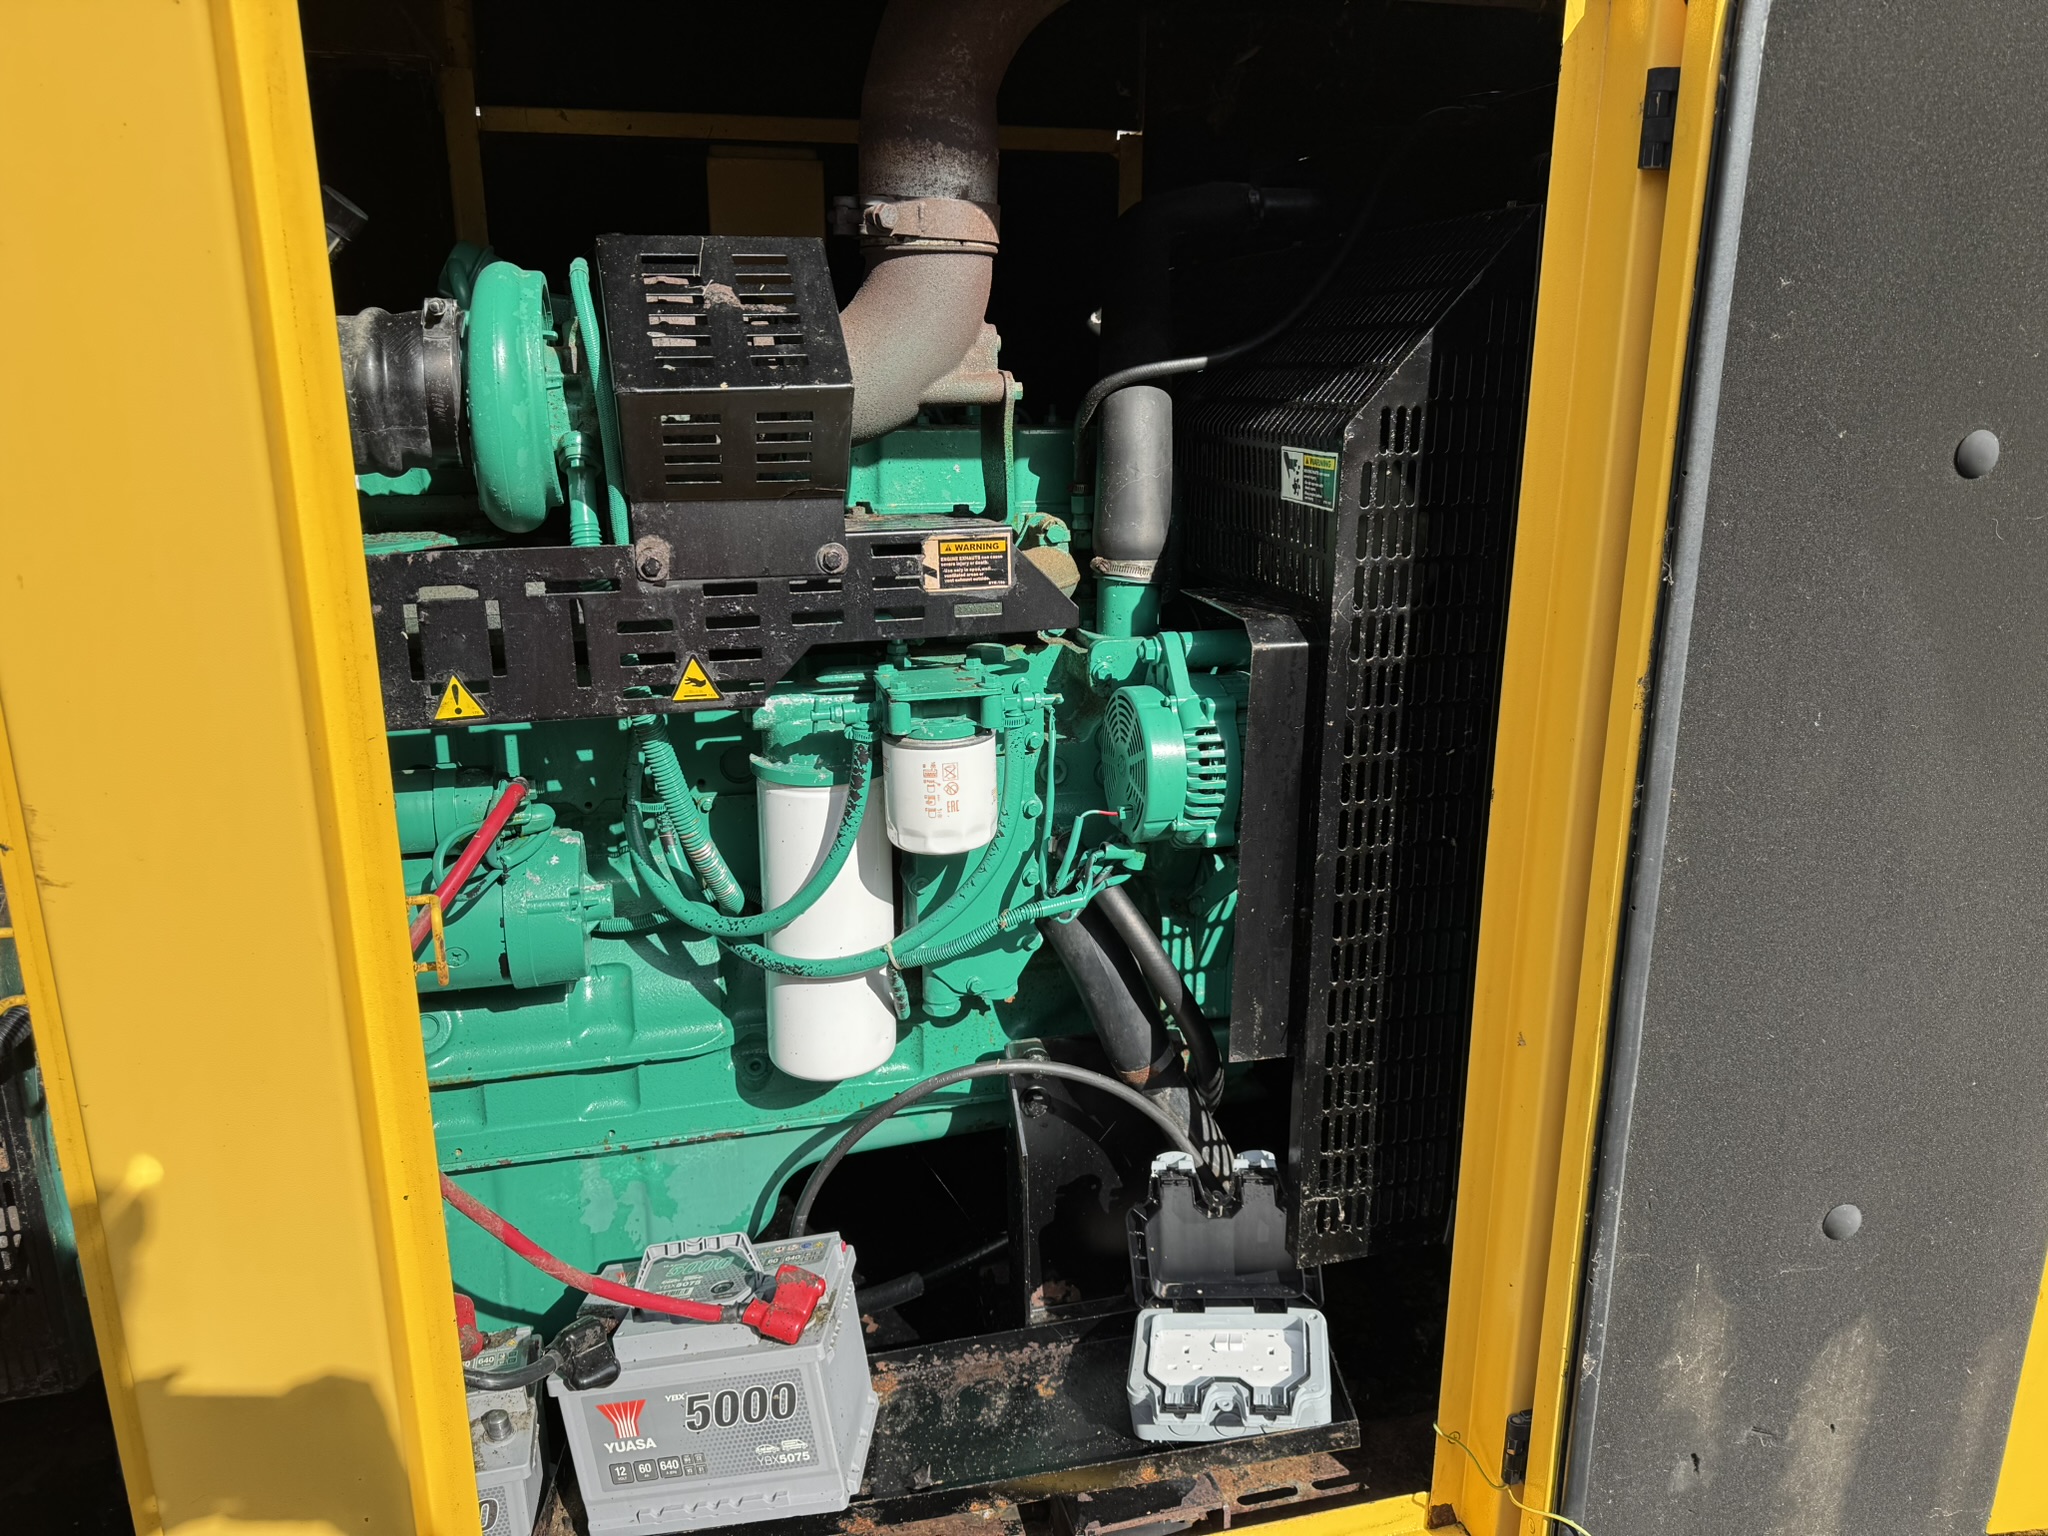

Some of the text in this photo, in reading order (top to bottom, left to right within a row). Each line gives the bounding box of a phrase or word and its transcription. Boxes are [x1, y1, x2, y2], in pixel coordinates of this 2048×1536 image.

[1310, 458, 1332, 468] WARNING
[954, 542, 1000, 552] WARNING
[666, 1256, 735, 1277] 5000
[478, 1357, 494, 1365] 640
[685, 1381, 797, 1432] 5000
[604, 1437, 657, 1454] YUASA
[756, 1451, 810, 1466] YBX5075
[614, 1466, 627, 1476] 12
[638, 1463, 652, 1474] 60
[660, 1460, 679, 1471] 640
